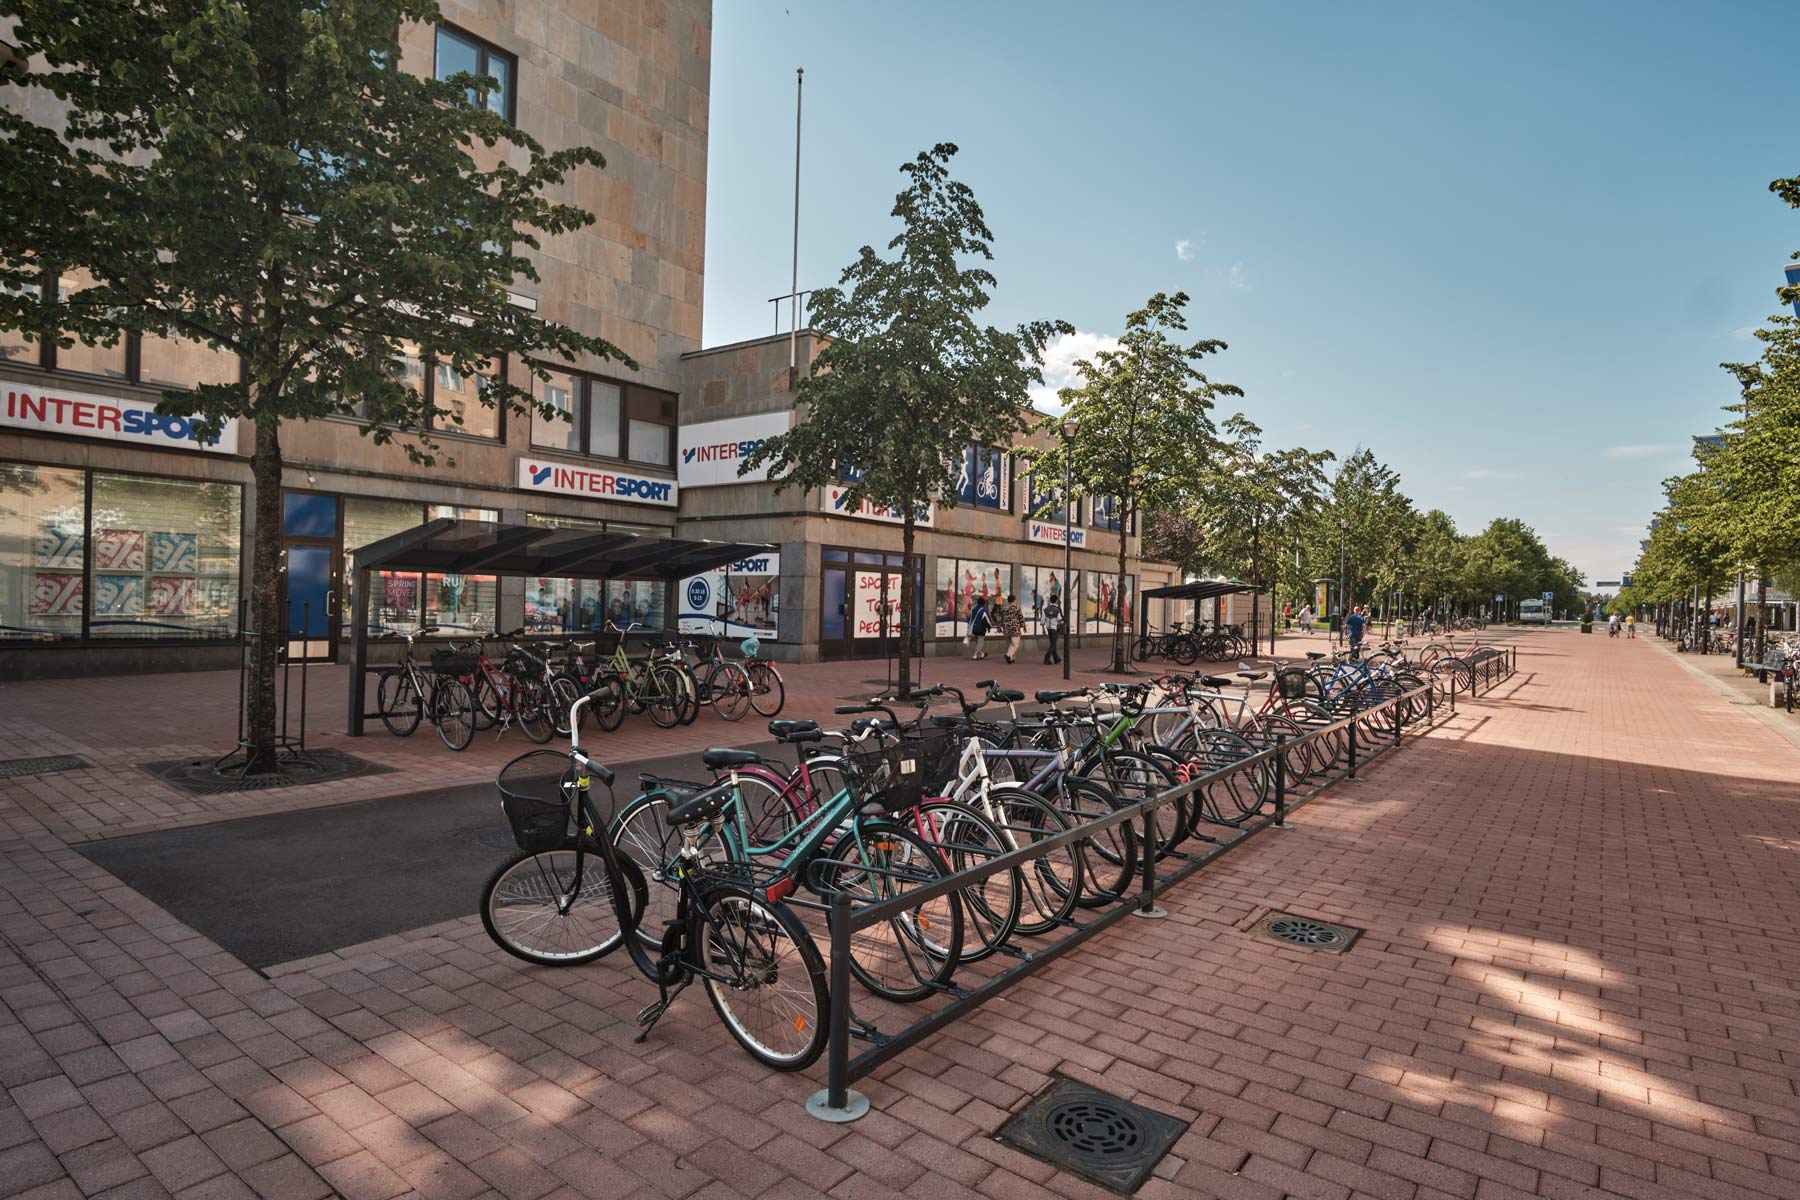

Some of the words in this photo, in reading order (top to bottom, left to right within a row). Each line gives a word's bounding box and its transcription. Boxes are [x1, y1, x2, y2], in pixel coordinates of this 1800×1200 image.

[697, 438, 767, 462] INTERSP
[554, 468, 671, 501] INTERSPORT
[1041, 526, 1083, 544] INTERSORT
[388, 580, 416, 588] SPRING
[387, 588, 415, 597] MOVES
[887, 600, 901, 612] TH
[860, 620, 901, 633] PEOE
